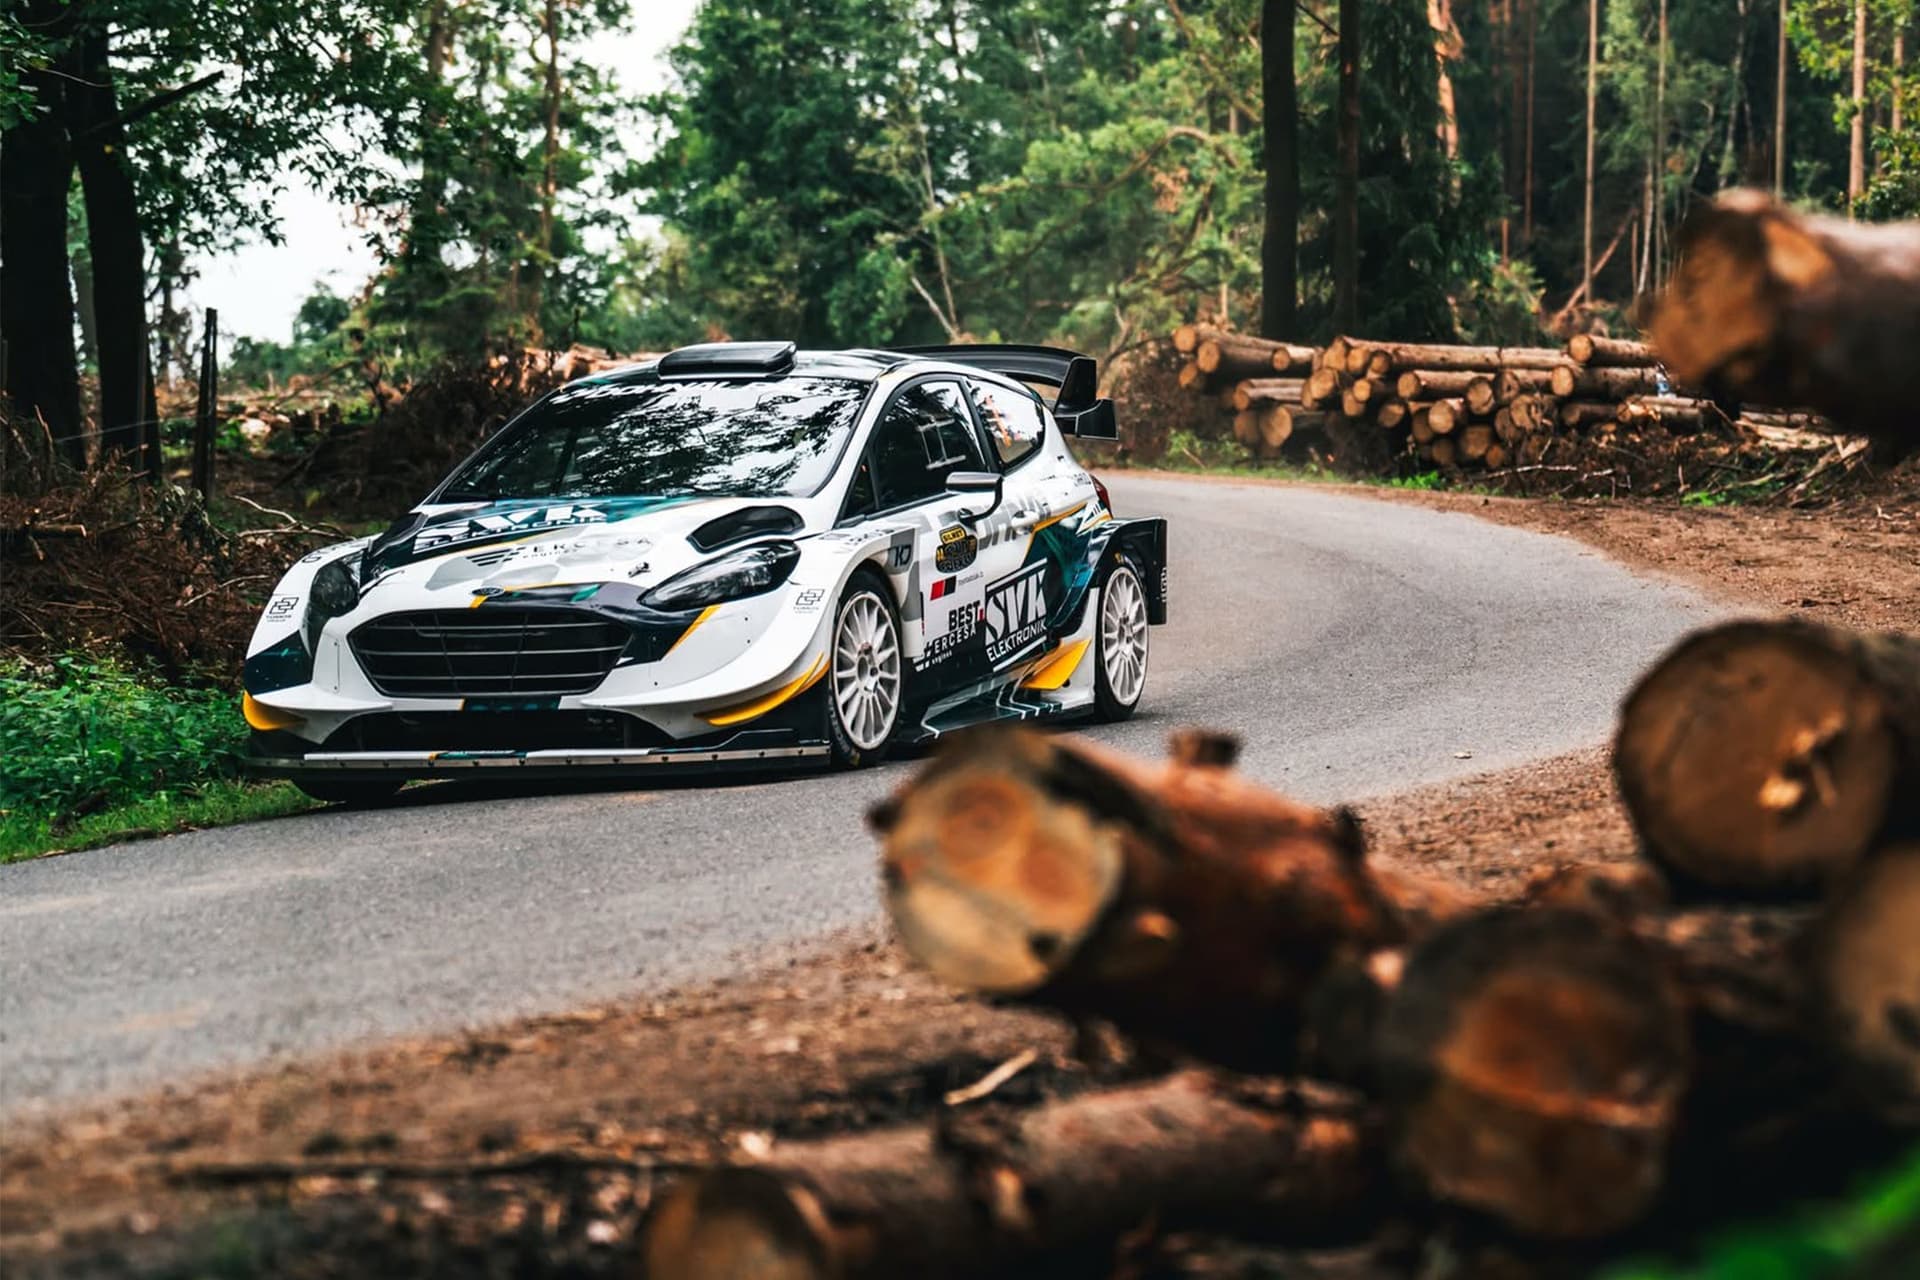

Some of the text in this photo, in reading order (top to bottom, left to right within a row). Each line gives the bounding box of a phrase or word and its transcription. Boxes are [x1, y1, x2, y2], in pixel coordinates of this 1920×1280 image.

[948, 600, 980, 632] BEST
[984, 569, 1047, 646] SVK
[985, 619, 1048, 663] ELEKTRONIK
